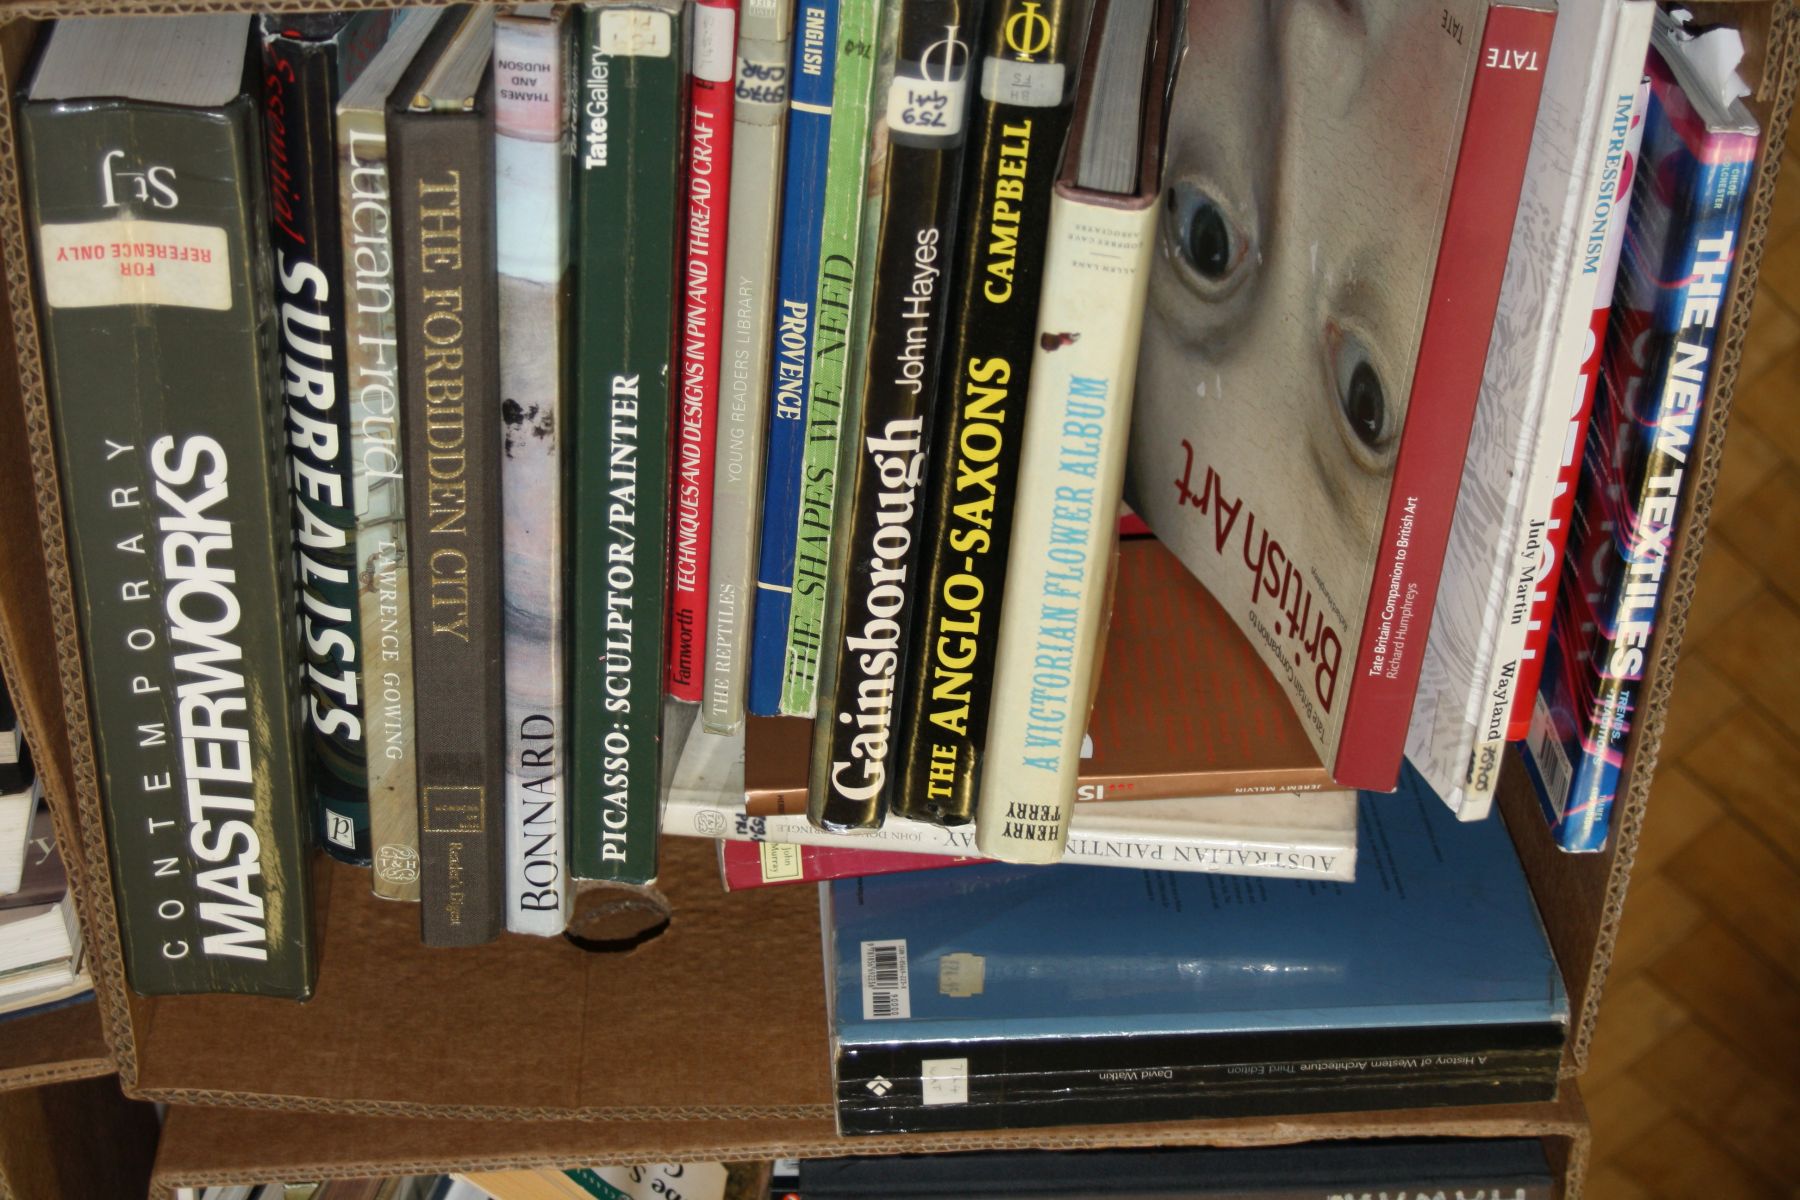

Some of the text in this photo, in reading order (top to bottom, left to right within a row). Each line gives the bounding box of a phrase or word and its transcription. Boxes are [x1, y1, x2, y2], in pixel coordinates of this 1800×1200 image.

[802, 8, 824, 75] ENGLISH
[1440, 9, 1464, 45] TATE
[1485, 47, 1539, 72] TATE
[498, 58, 551, 74] HUDSON
[500, 88, 552, 103] THAMES
[511, 75, 538, 88] AND
[741, 60, 785, 82] CAR
[692, 105, 715, 176] CRAFT
[901, 106, 948, 128] 759
[689, 177, 712, 256] THREAD
[984, 118, 1033, 304] CAMPBELL
[1582, 93, 1634, 275] IMPRESSIONISM
[56, 241, 213, 264] REFERENCE ONLY
[349, 129, 393, 315] Lucian
[120, 261, 156, 278] FOR
[688, 259, 708, 305] AND
[686, 304, 706, 338] PIN
[895, 228, 940, 395] John Hayes
[685, 338, 705, 369] IN
[728, 275, 754, 484] YOUNG READERS LIBRARY
[776, 298, 809, 421] PROVENCE
[359, 334, 404, 482] Freud
[418, 170, 470, 644] THE FORBIDDEN CITY
[680, 380, 704, 441] DESIGNS
[678, 440, 701, 486] AND
[787, 253, 854, 684] THE SHAPES WE NEED
[1610, 230, 1734, 679] THE NEW TEXTILES
[276, 247, 362, 742] SURREALISTS
[676, 486, 700, 593] TECHNIQUES
[1021, 373, 1110, 773] A VICTORIAN FLOWER ALBUM
[1173, 438, 1343, 714] British Art
[1510, 519, 1546, 625] Judy Martin
[830, 414, 930, 800] Gainsborough
[926, 356, 1012, 800] THE ANGLO-SAXONS
[1368, 496, 1418, 677] Tate Britain Companion to British Art
[377, 541, 404, 760] LAWRENCE GOWING
[602, 374, 640, 863] PICASSO: SCULPTOR/PAINTER
[712, 581, 736, 717] THE REPTILES
[1386, 582, 1419, 680] Richard Humphreys
[105, 438, 190, 961] CONTEMPORARY
[150, 434, 268, 962] MASTERWORKS
[1312, 712, 1325, 745] Tate
[1487, 659, 1518, 741] Wayland
[520, 713, 561, 914] BONNARD
[1005, 801, 1062, 822] TERRY
[1234, 783, 1322, 793] JEREMY MELVIN
[769, 842, 780, 872] Murray
[781, 847, 793, 867] John
[891, 831, 922, 842] JOHN
[1002, 823, 1060, 842] HENRY
[1064, 838, 1164, 861] PAINTIN
[1173, 845, 1337, 873] AUSTRALIAN
[1098, 1069, 1173, 1081] David Watkin
[1226, 1055, 1488, 1075] A History of Western Architecture Third Edition
